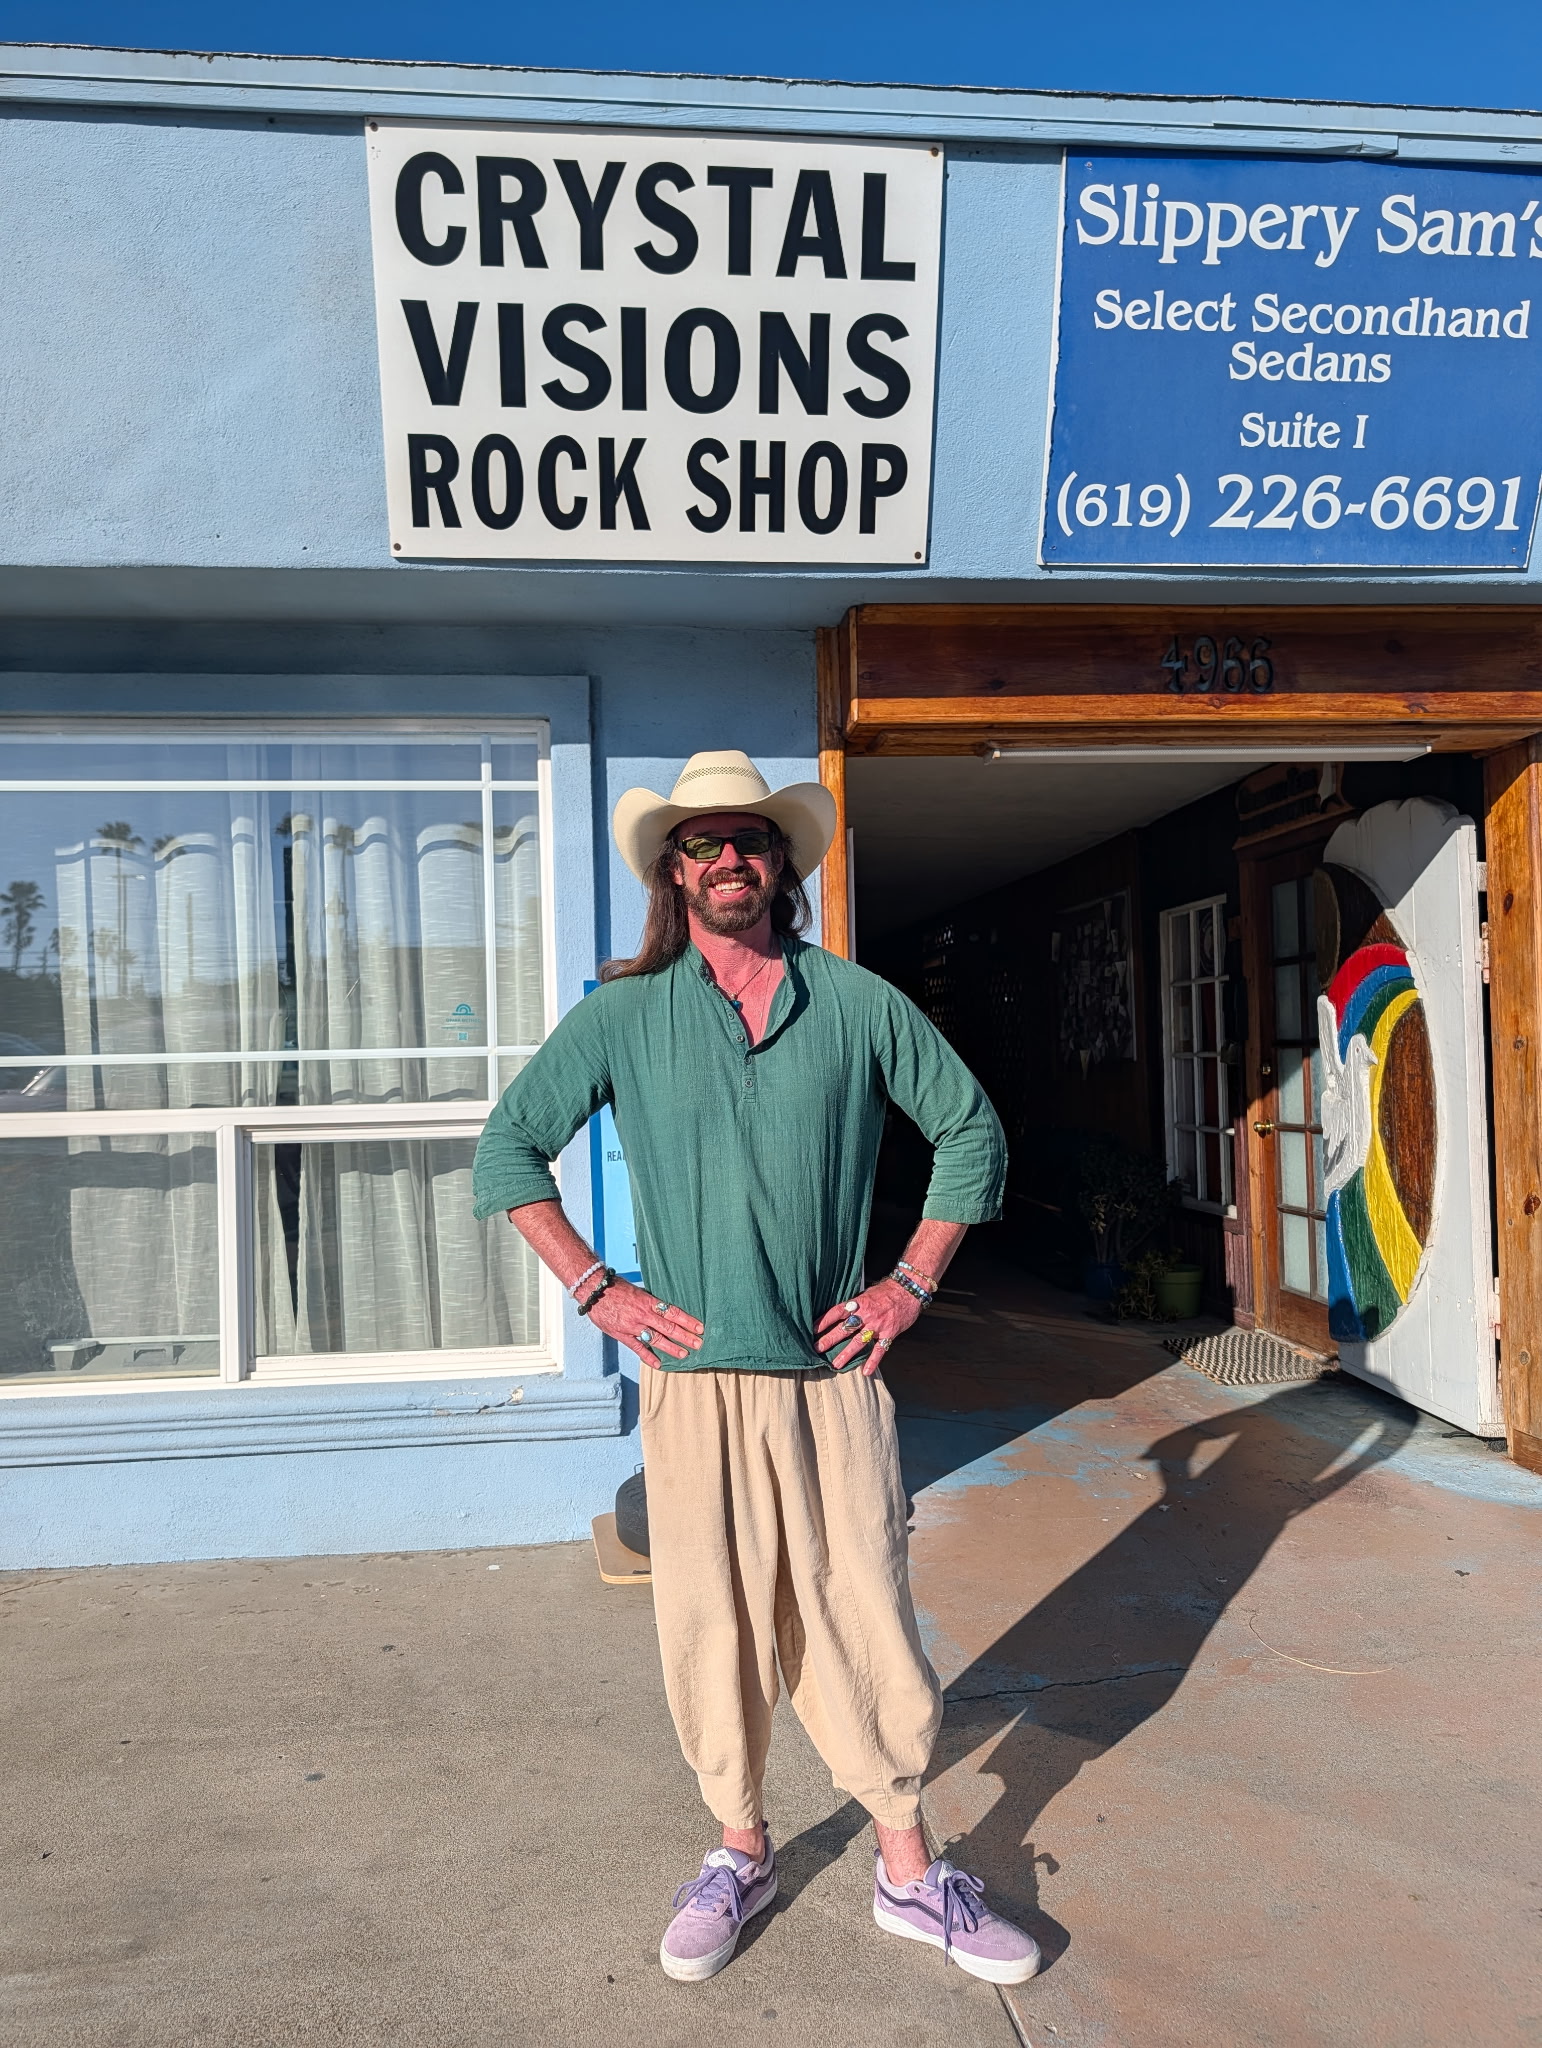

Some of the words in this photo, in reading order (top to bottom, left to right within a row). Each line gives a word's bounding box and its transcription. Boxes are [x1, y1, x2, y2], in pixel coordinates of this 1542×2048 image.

[395, 151, 916, 281] CRYSTAL
[1076, 184, 1359, 267] Slippery
[1094, 290, 1236, 331] Select
[1252, 294, 1530, 338] Secondhand
[401, 300, 911, 419] VISIONS
[1229, 342, 1391, 382] Sedans
[1240, 412, 1340, 448] Suite
[1353, 415, 1369, 448] I
[408, 434, 651, 530] ROCK
[686, 438, 907, 534] SHOP
[1057, 471, 1190, 537] (619)
[1209, 474, 1521, 531] 226-6691
[1161, 635, 1274, 693] 4966
[607, 1150, 626, 1162] REA
